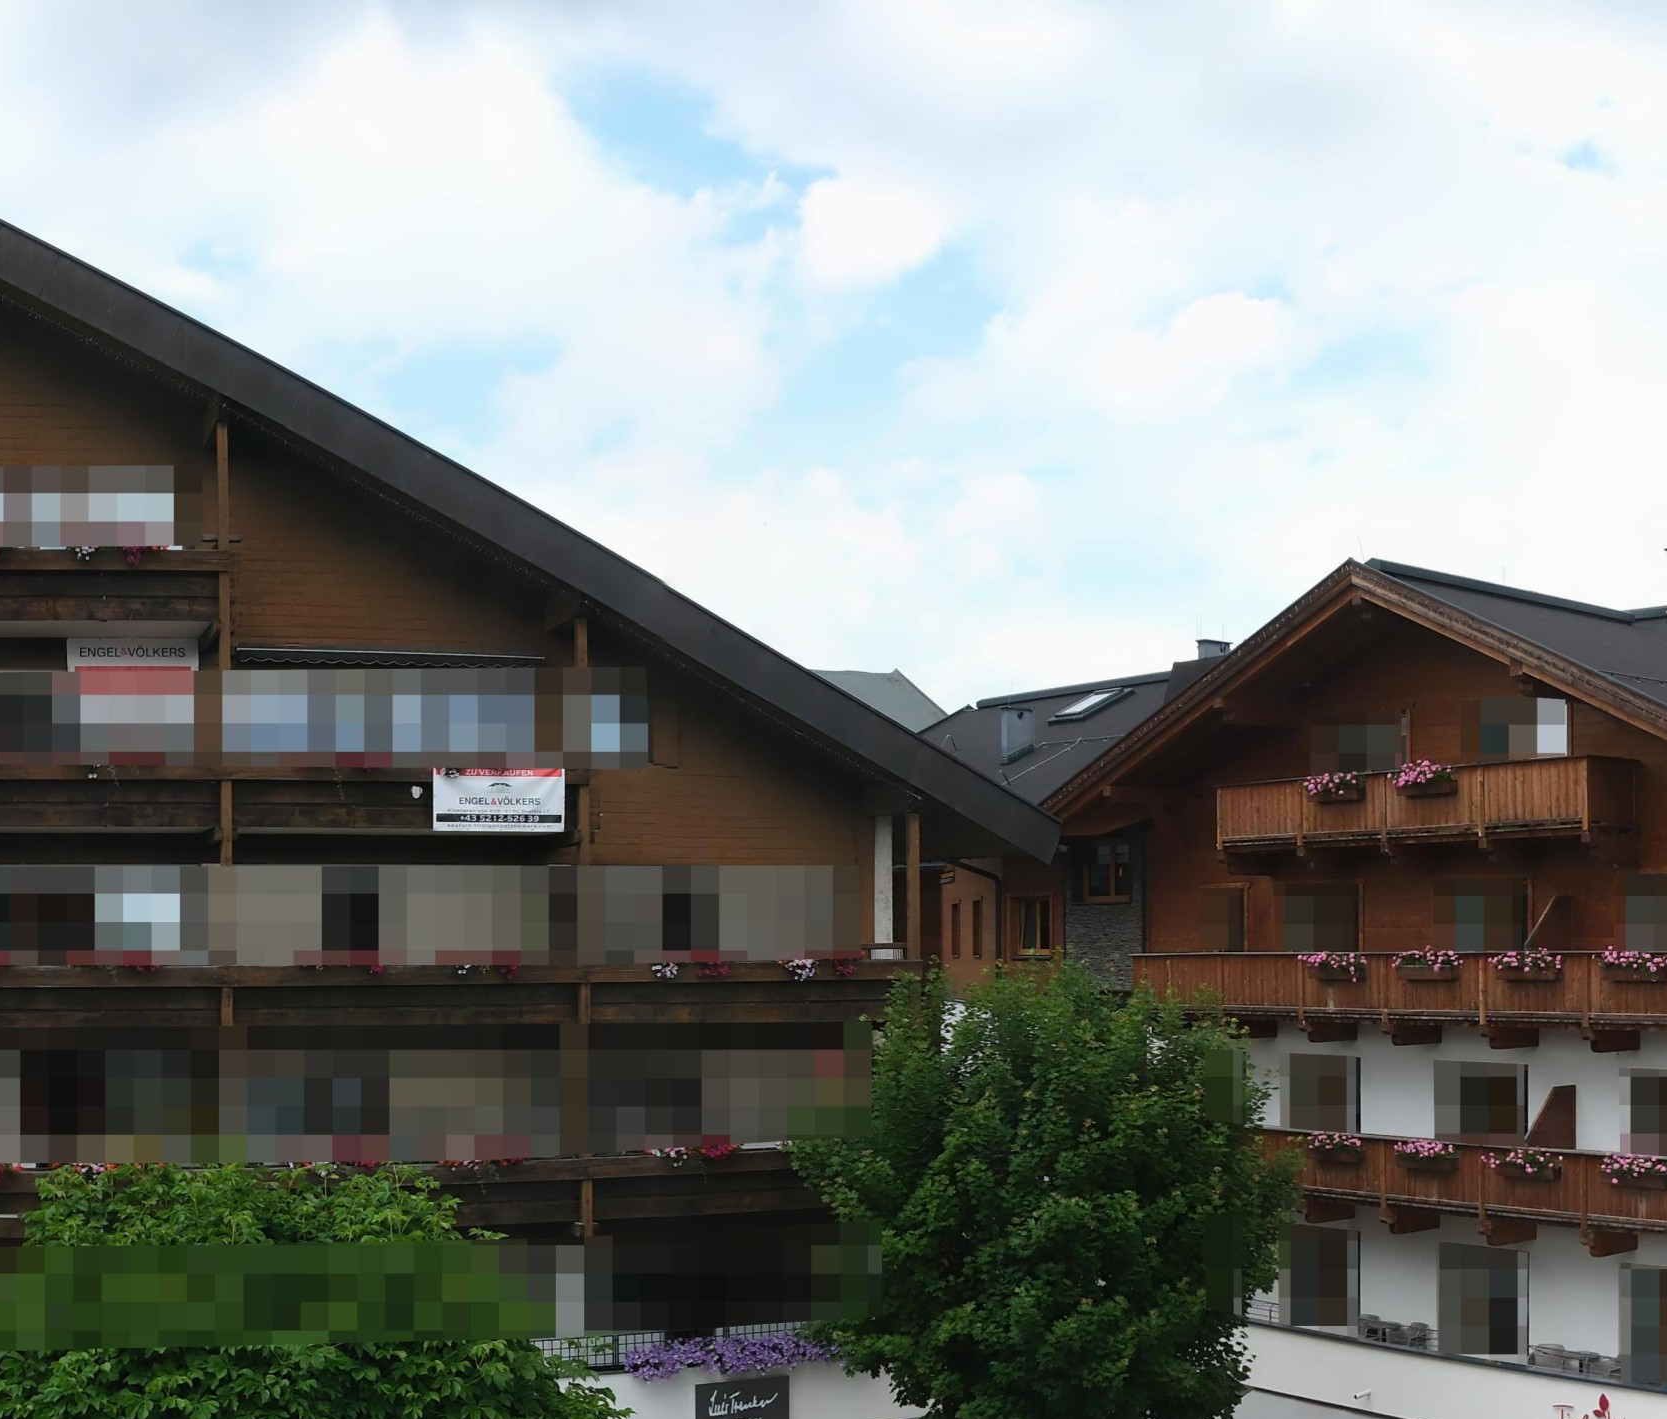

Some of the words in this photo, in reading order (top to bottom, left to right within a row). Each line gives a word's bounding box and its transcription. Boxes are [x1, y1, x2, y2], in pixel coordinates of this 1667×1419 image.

[79, 645, 186, 658] ENGEL&VÖLKERS
[479, 769, 534, 777] VERKAUFEN
[458, 796, 541, 806] ENGEL&VÖLKERS
[527, 815, 540, 823] 39
